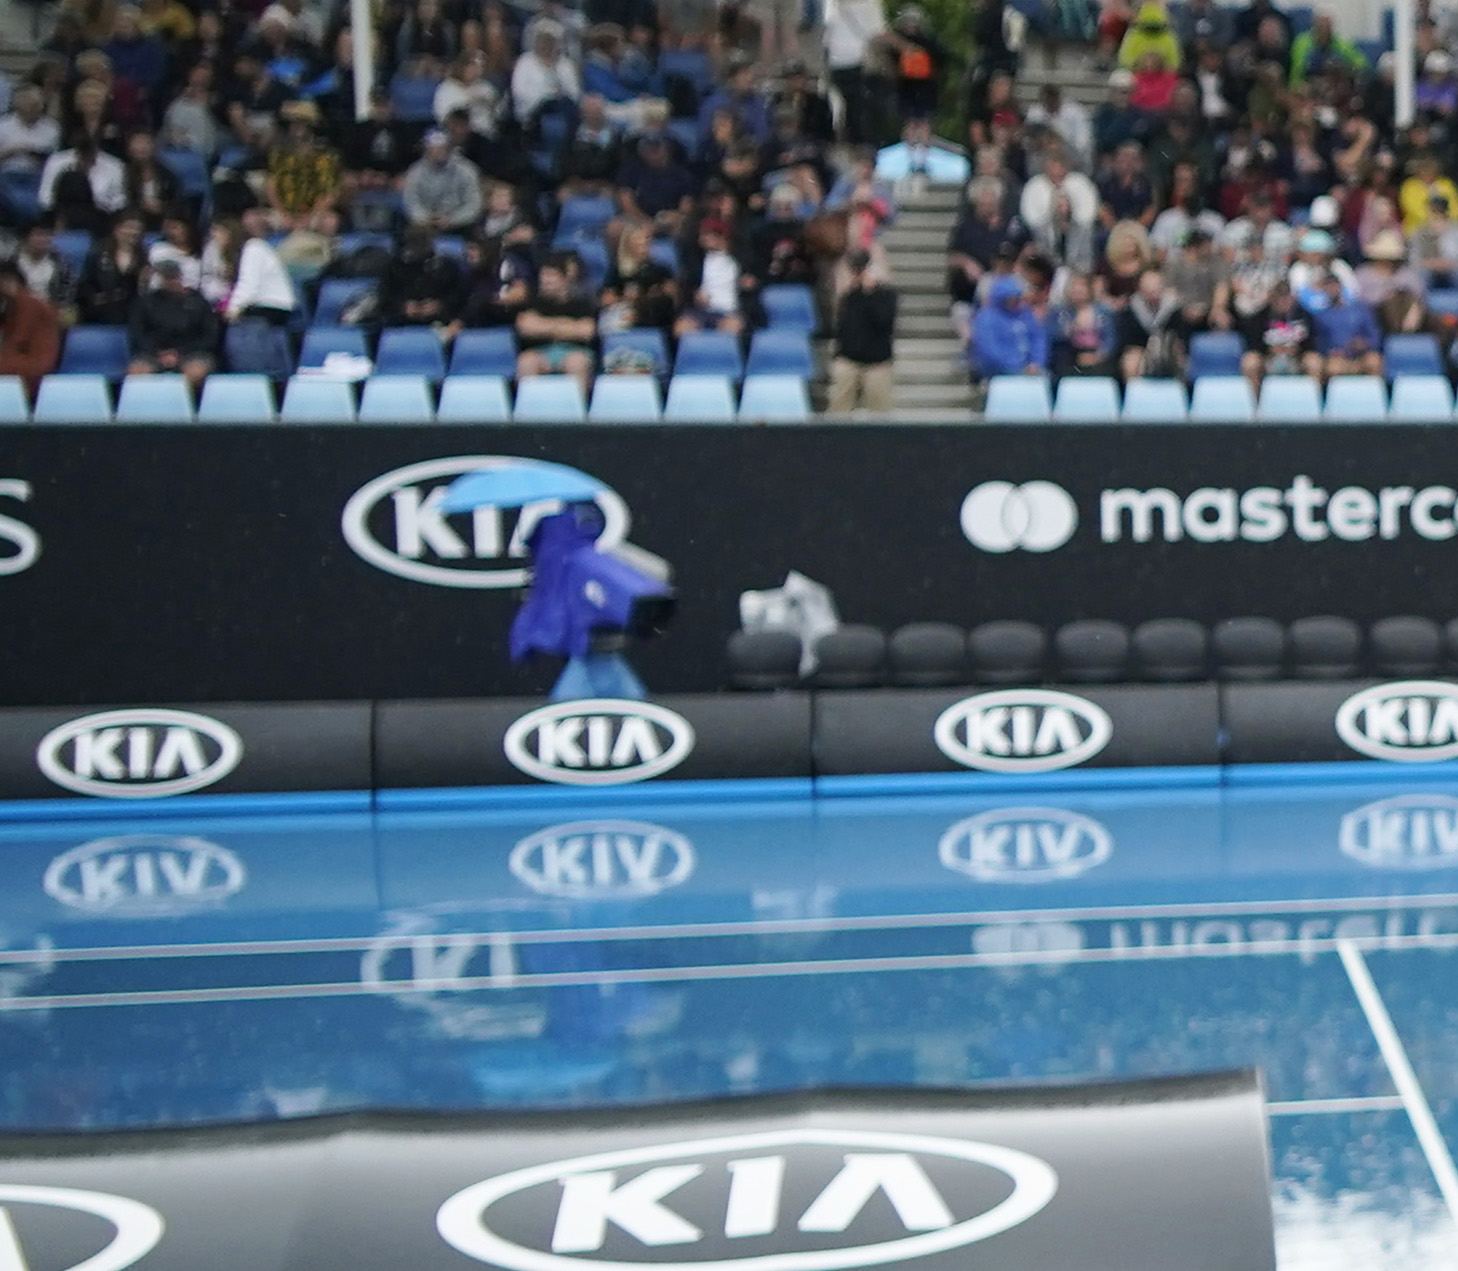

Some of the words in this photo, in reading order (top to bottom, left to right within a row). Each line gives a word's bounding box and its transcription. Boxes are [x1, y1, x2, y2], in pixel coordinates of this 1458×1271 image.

[73, 727, 204, 779] KIA
[538, 717, 663, 767] KIA
[966, 707, 1082, 756] KIA
[550, 1151, 958, 1253] KIA
